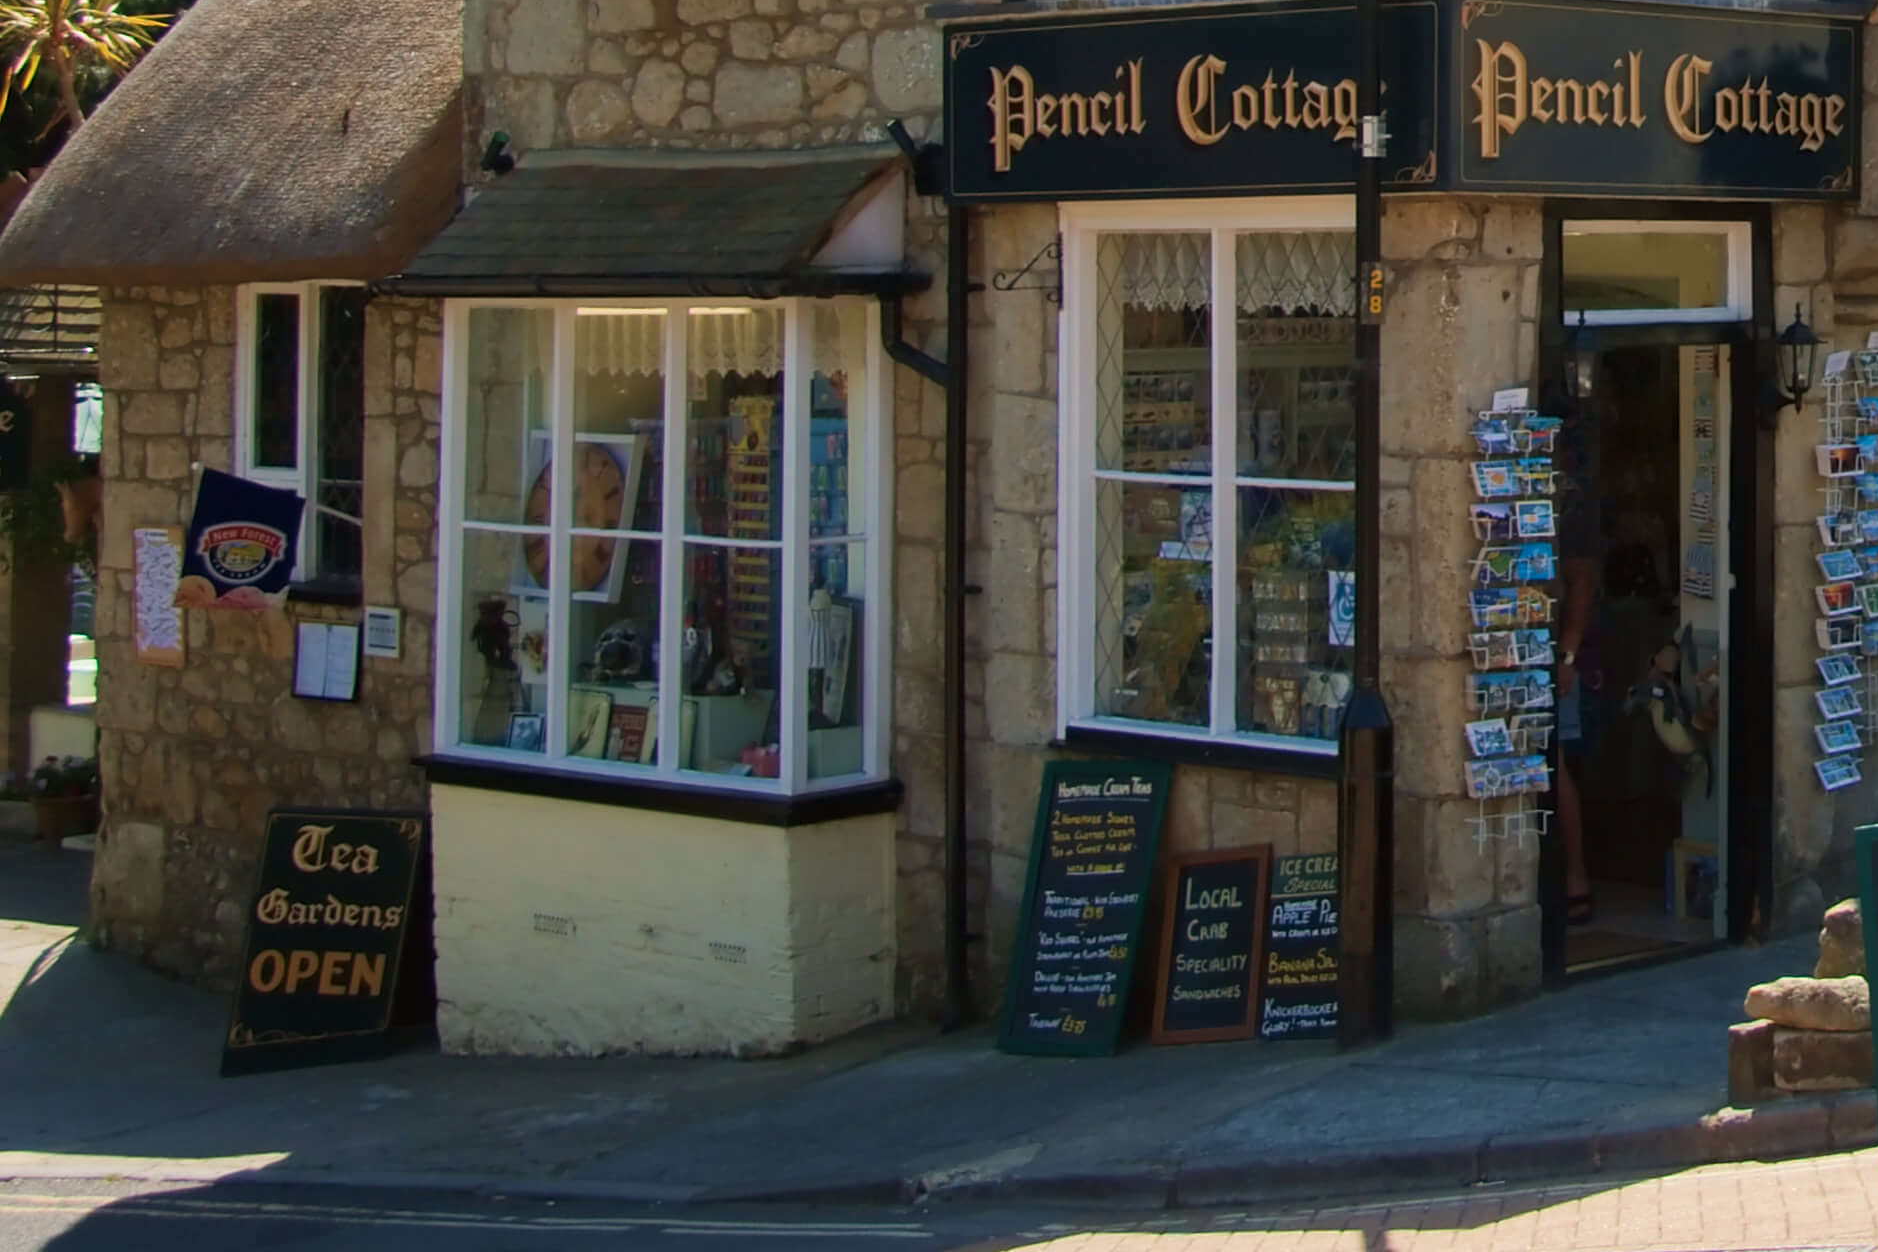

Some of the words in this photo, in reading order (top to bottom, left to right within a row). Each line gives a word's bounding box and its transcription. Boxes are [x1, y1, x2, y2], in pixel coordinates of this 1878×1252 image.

[986, 56, 1147, 173] Pencil
[1176, 54, 1388, 147] Cottag
[1472, 37, 1646, 159] Pencil
[1664, 52, 1846, 153] Cottage
[291, 824, 381, 875] Tea
[1280, 859, 1302, 876] ICE
[1305, 856, 1338, 874] CREA
[256, 887, 404, 930] Gardens
[1185, 877, 1243, 910] LOCAL
[1187, 919, 1229, 941] CRAB
[1272, 904, 1312, 926] APPLE
[249, 948, 387, 997] OPEN
[1175, 953, 1247, 975] SPECIALITY
[1172, 984, 1241, 1001] SANDWICHES
